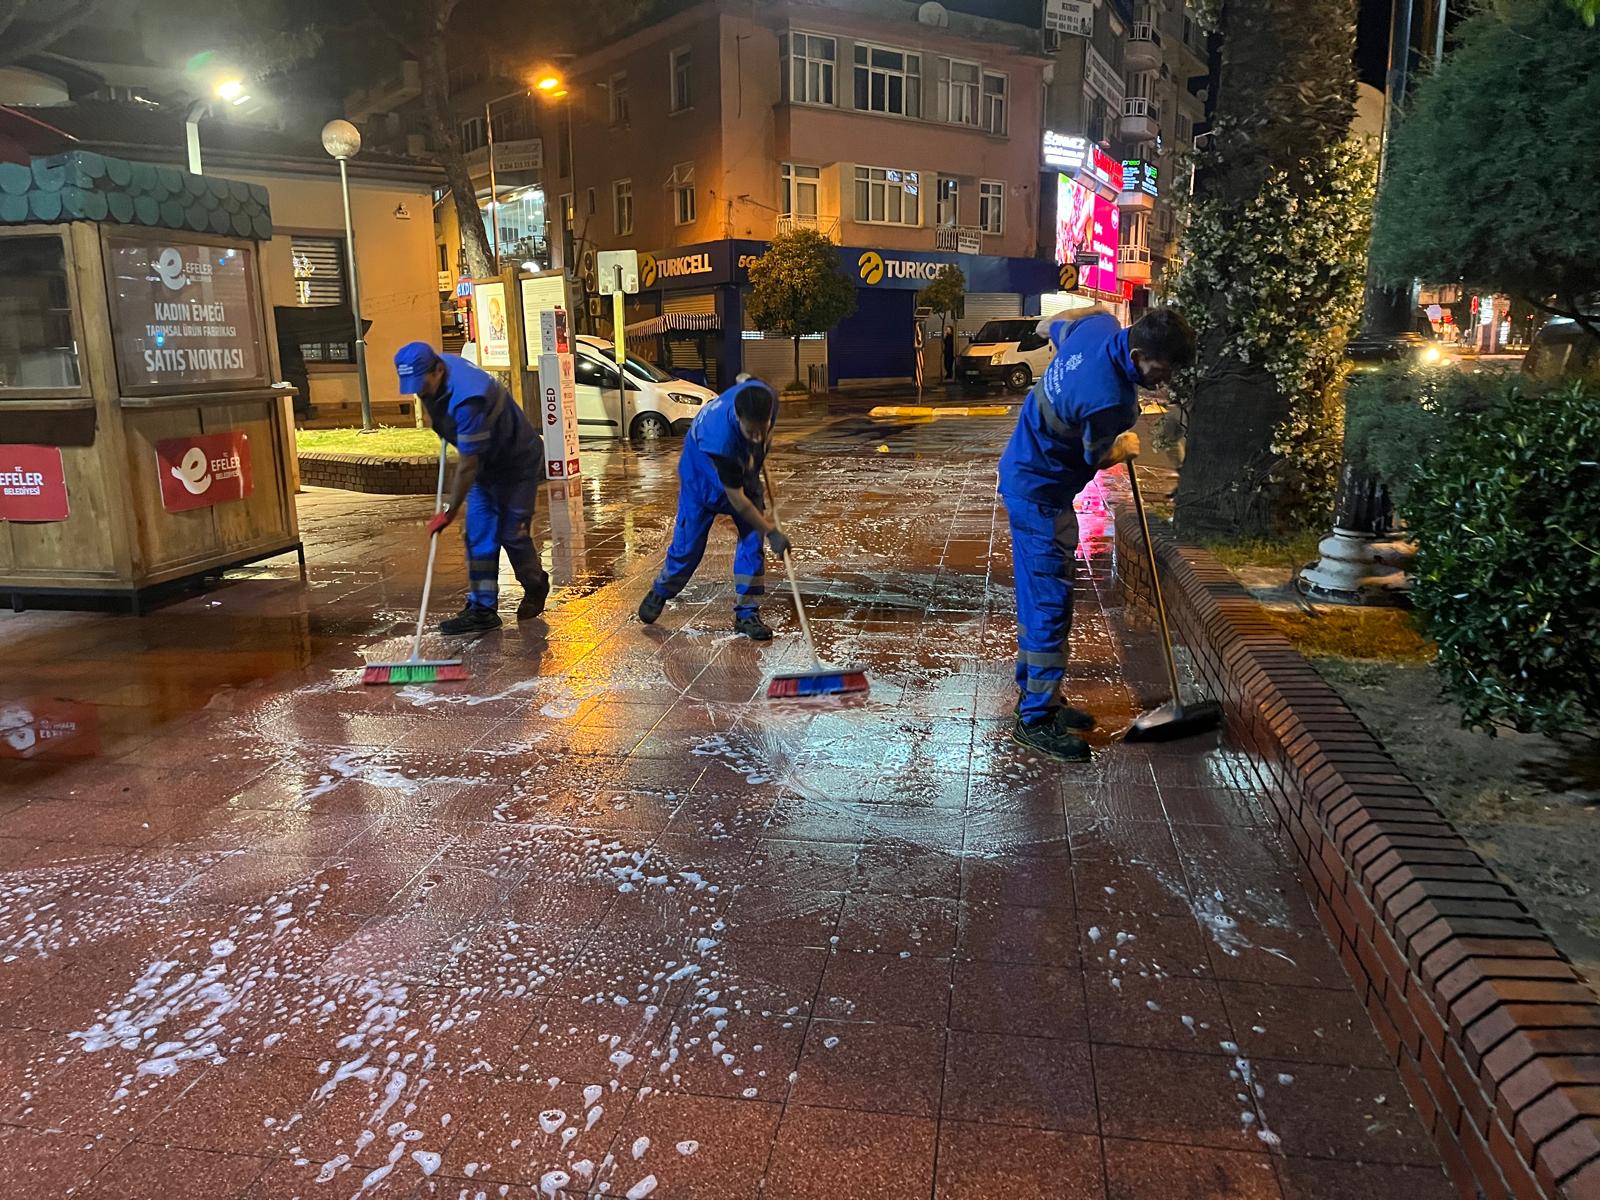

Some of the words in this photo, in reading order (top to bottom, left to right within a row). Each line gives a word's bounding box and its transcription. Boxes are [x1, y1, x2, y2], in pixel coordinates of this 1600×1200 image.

[185, 262, 213, 275] EFELER
[656, 253, 713, 278] TURKCELL
[885, 260, 958, 280] TURKCE
[154, 303, 190, 320] KADIN
[192, 301, 225, 321] EMEĞİ
[144, 349, 186, 376] SATIŞ
[188, 348, 244, 370] NOKTASI
[546, 387, 557, 412] OED
[211, 456, 240, 472] EFELER
[0, 472, 44, 486] EFELER
